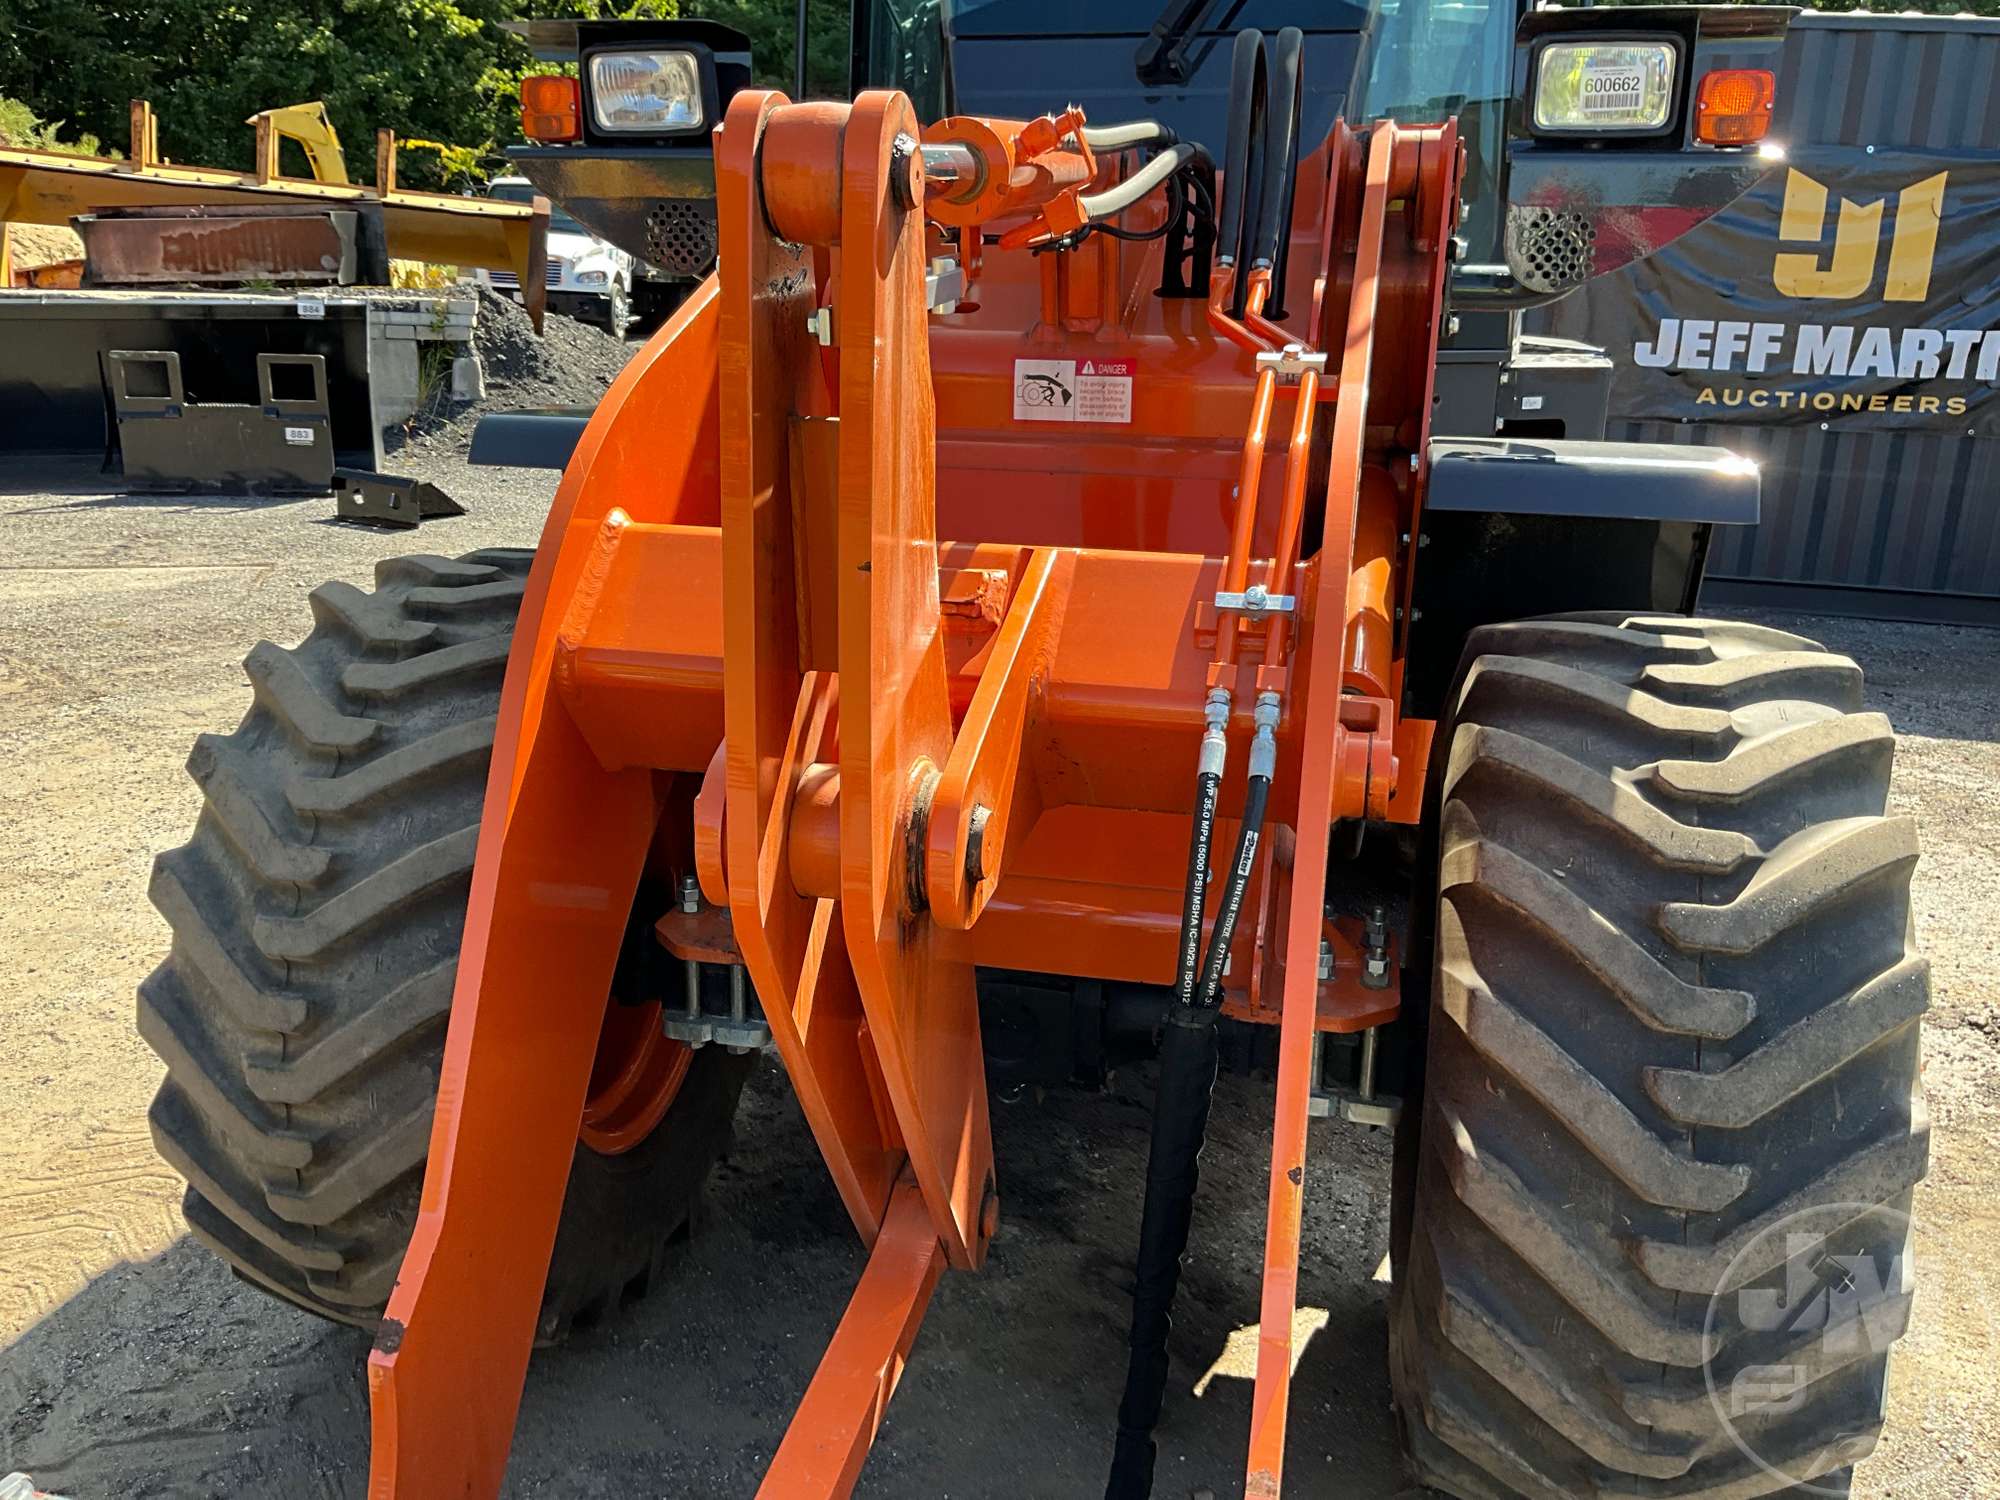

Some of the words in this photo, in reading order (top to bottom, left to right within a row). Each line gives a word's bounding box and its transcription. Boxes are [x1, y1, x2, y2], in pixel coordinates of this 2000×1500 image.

[1584, 77, 1641, 93] 600662
[1634, 318, 1786, 372] JEFF
[1098, 364, 1127, 374] DANGER
[1695, 387, 1968, 415] AUCTIONEERS
[290, 430, 309, 438] 883
[1206, 780, 1215, 795] WP
[1200, 820, 1210, 842] MPa
[1196, 844, 1207, 870] (5000
[1239, 834, 1256, 874] Parker
[1193, 873, 1203, 894] PSI)
[1230, 879, 1245, 911] TOUGH
[1191, 896, 1201, 925] MSHA
[1182, 971, 1193, 1007] ISO112
[1207, 981, 1217, 996] WP
